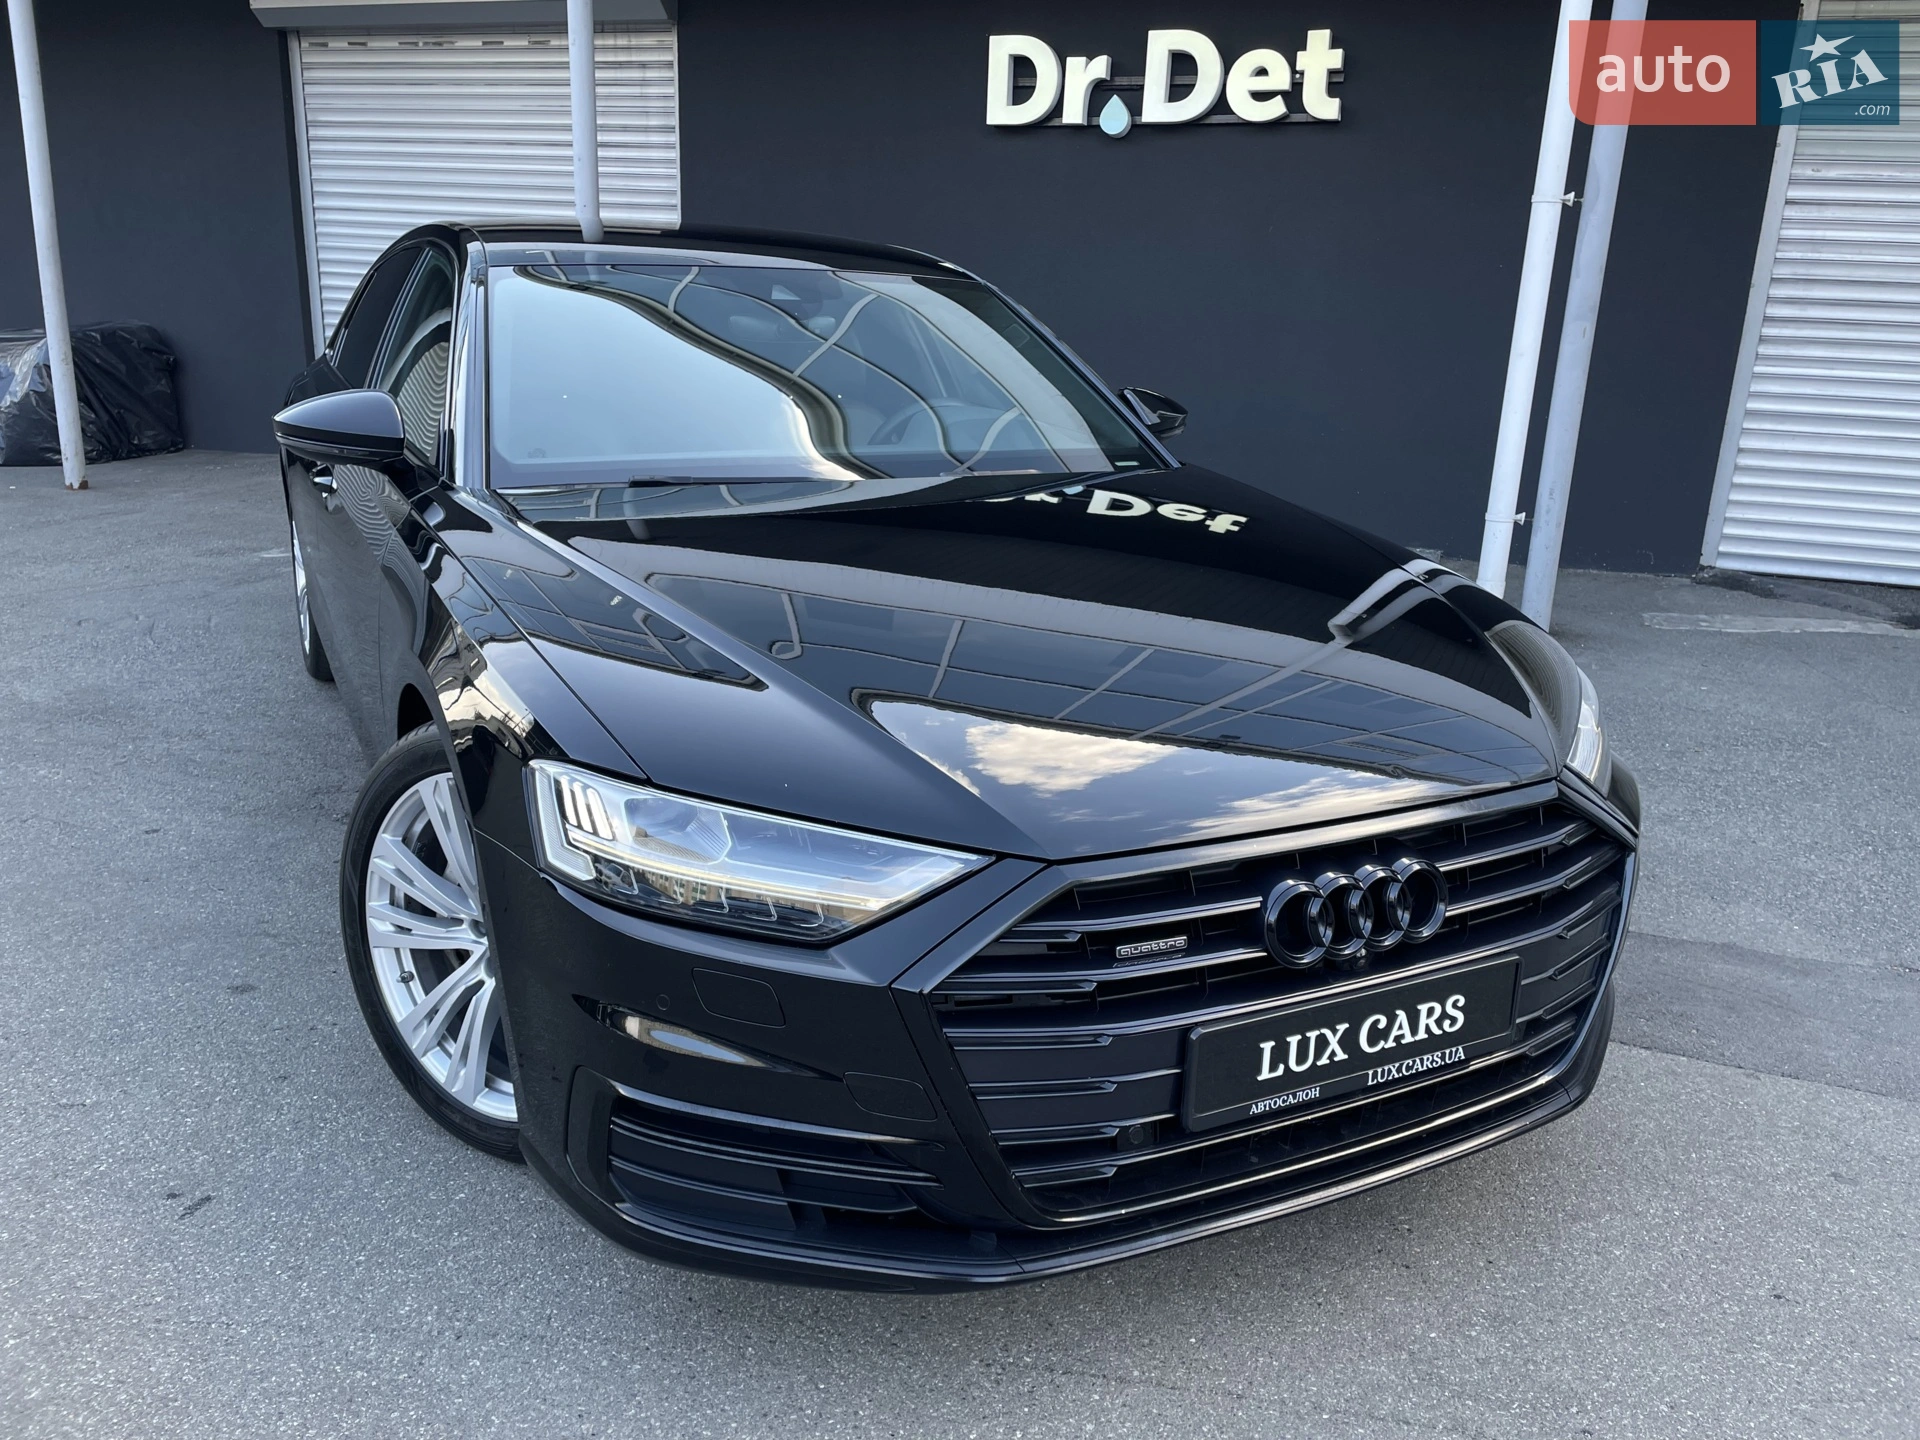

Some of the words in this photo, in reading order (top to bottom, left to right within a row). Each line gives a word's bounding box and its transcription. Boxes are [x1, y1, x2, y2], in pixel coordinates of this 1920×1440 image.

[1120, 939, 1185, 956] quattro
[1256, 1023, 1350, 1081] LUX
[1359, 994, 1466, 1054] CARS
[1367, 1046, 1466, 1086] LUX.CARS.UA
[1249, 1086, 1321, 1115] АВТОСАЛОН
